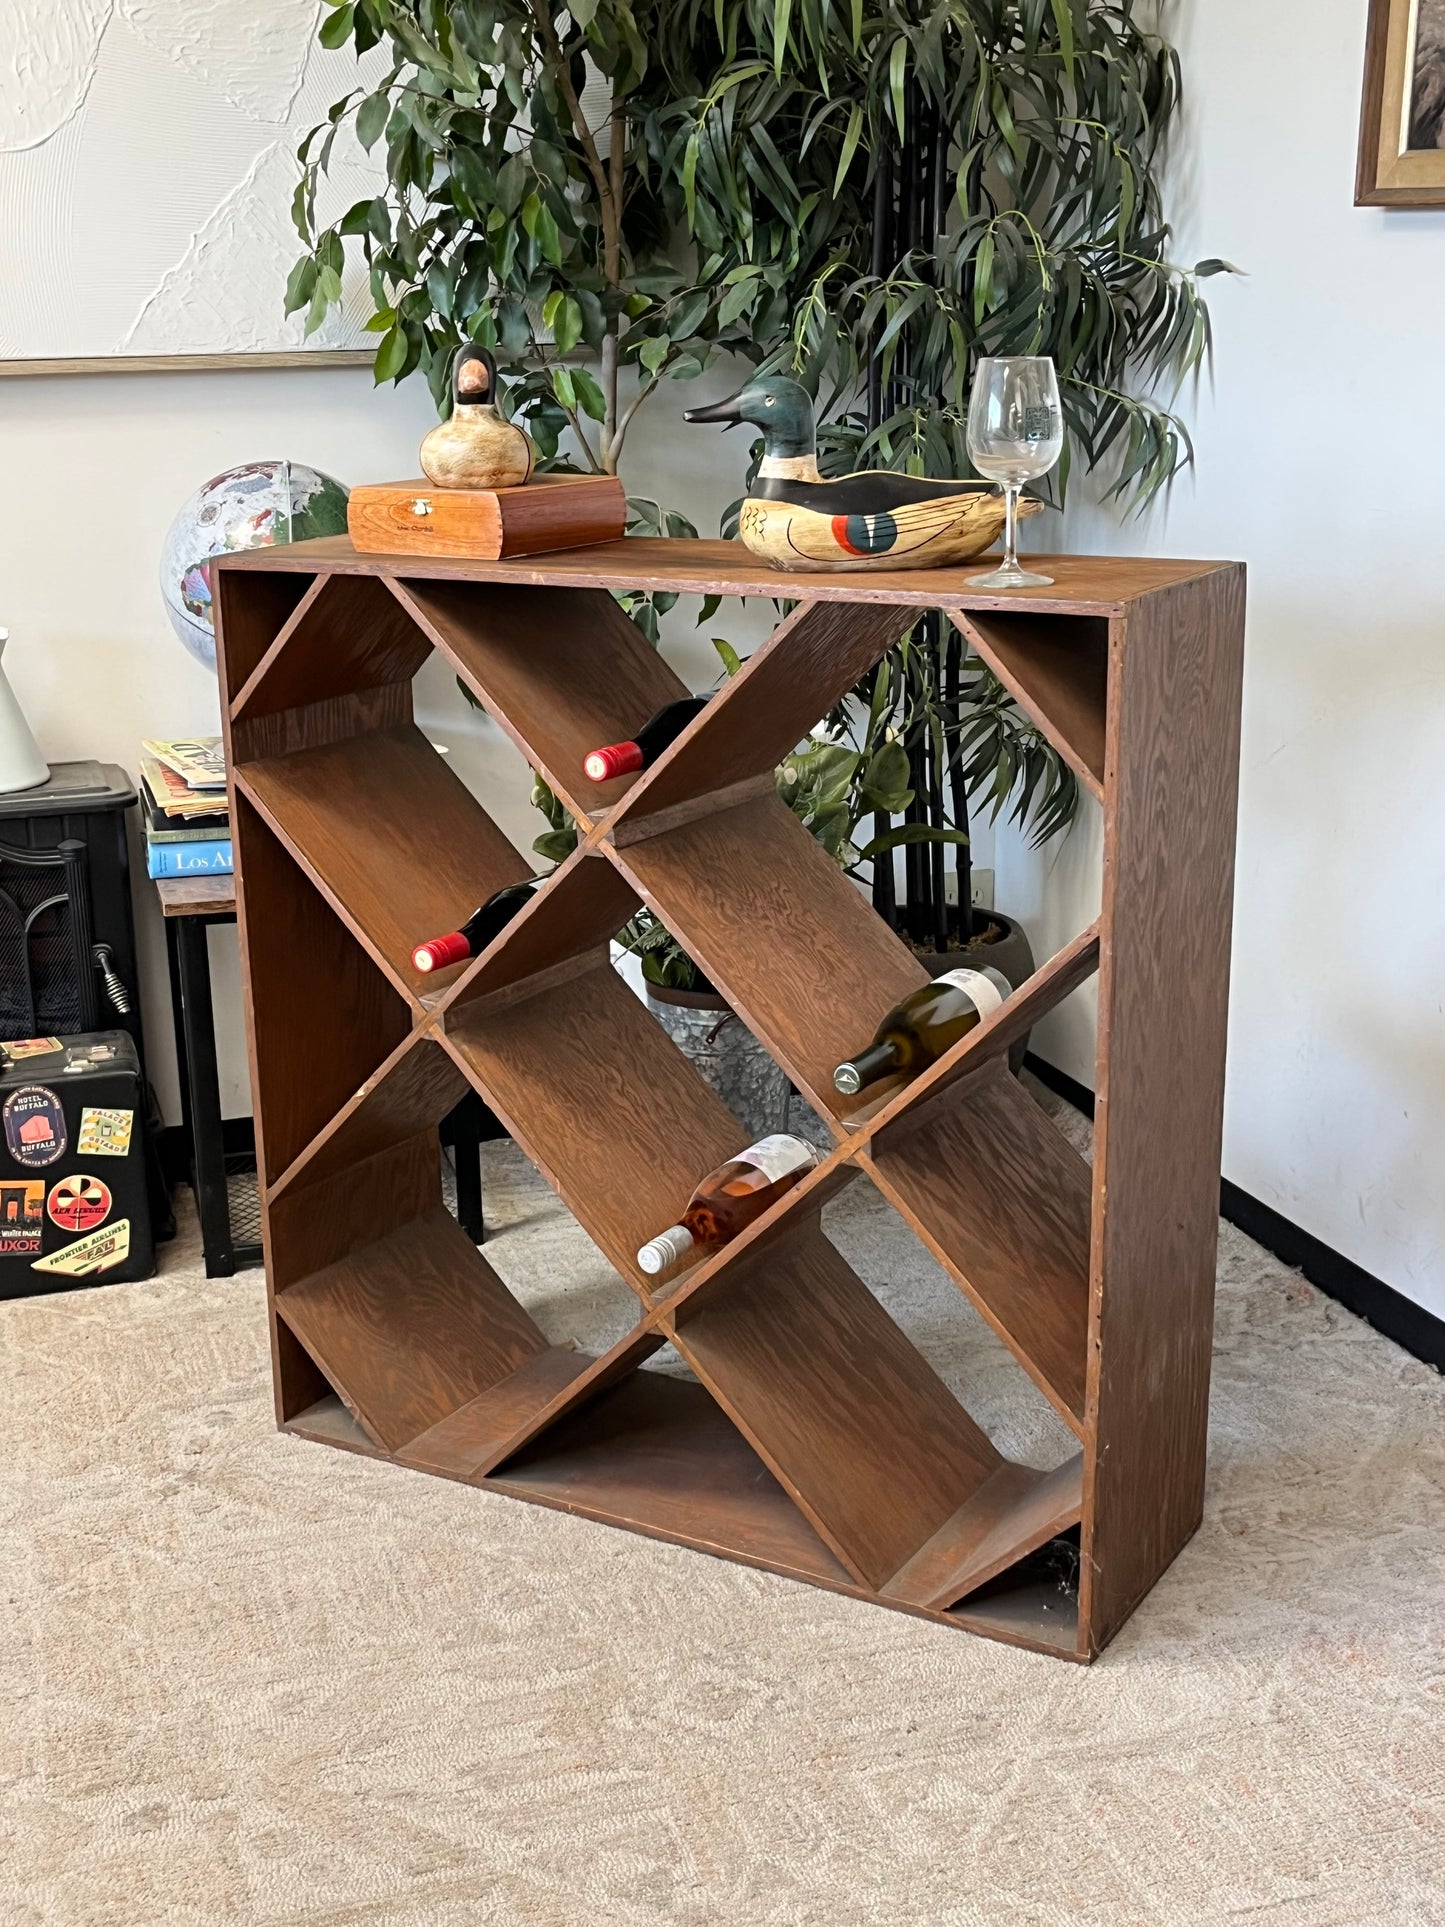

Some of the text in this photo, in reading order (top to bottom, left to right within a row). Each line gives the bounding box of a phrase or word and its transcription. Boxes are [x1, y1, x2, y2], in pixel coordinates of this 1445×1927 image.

[176, 853, 209, 870] Los
[13, 1100, 49, 1112] BUFFALO
[17, 1095, 42, 1104] HOTEL
[92, 1110, 124, 1124] PALACE
[21, 1140, 56, 1152] BUFFALO
[49, 1223, 127, 1266] FRONTIER AIRLINES
[86, 1241, 112, 1260] FAL
